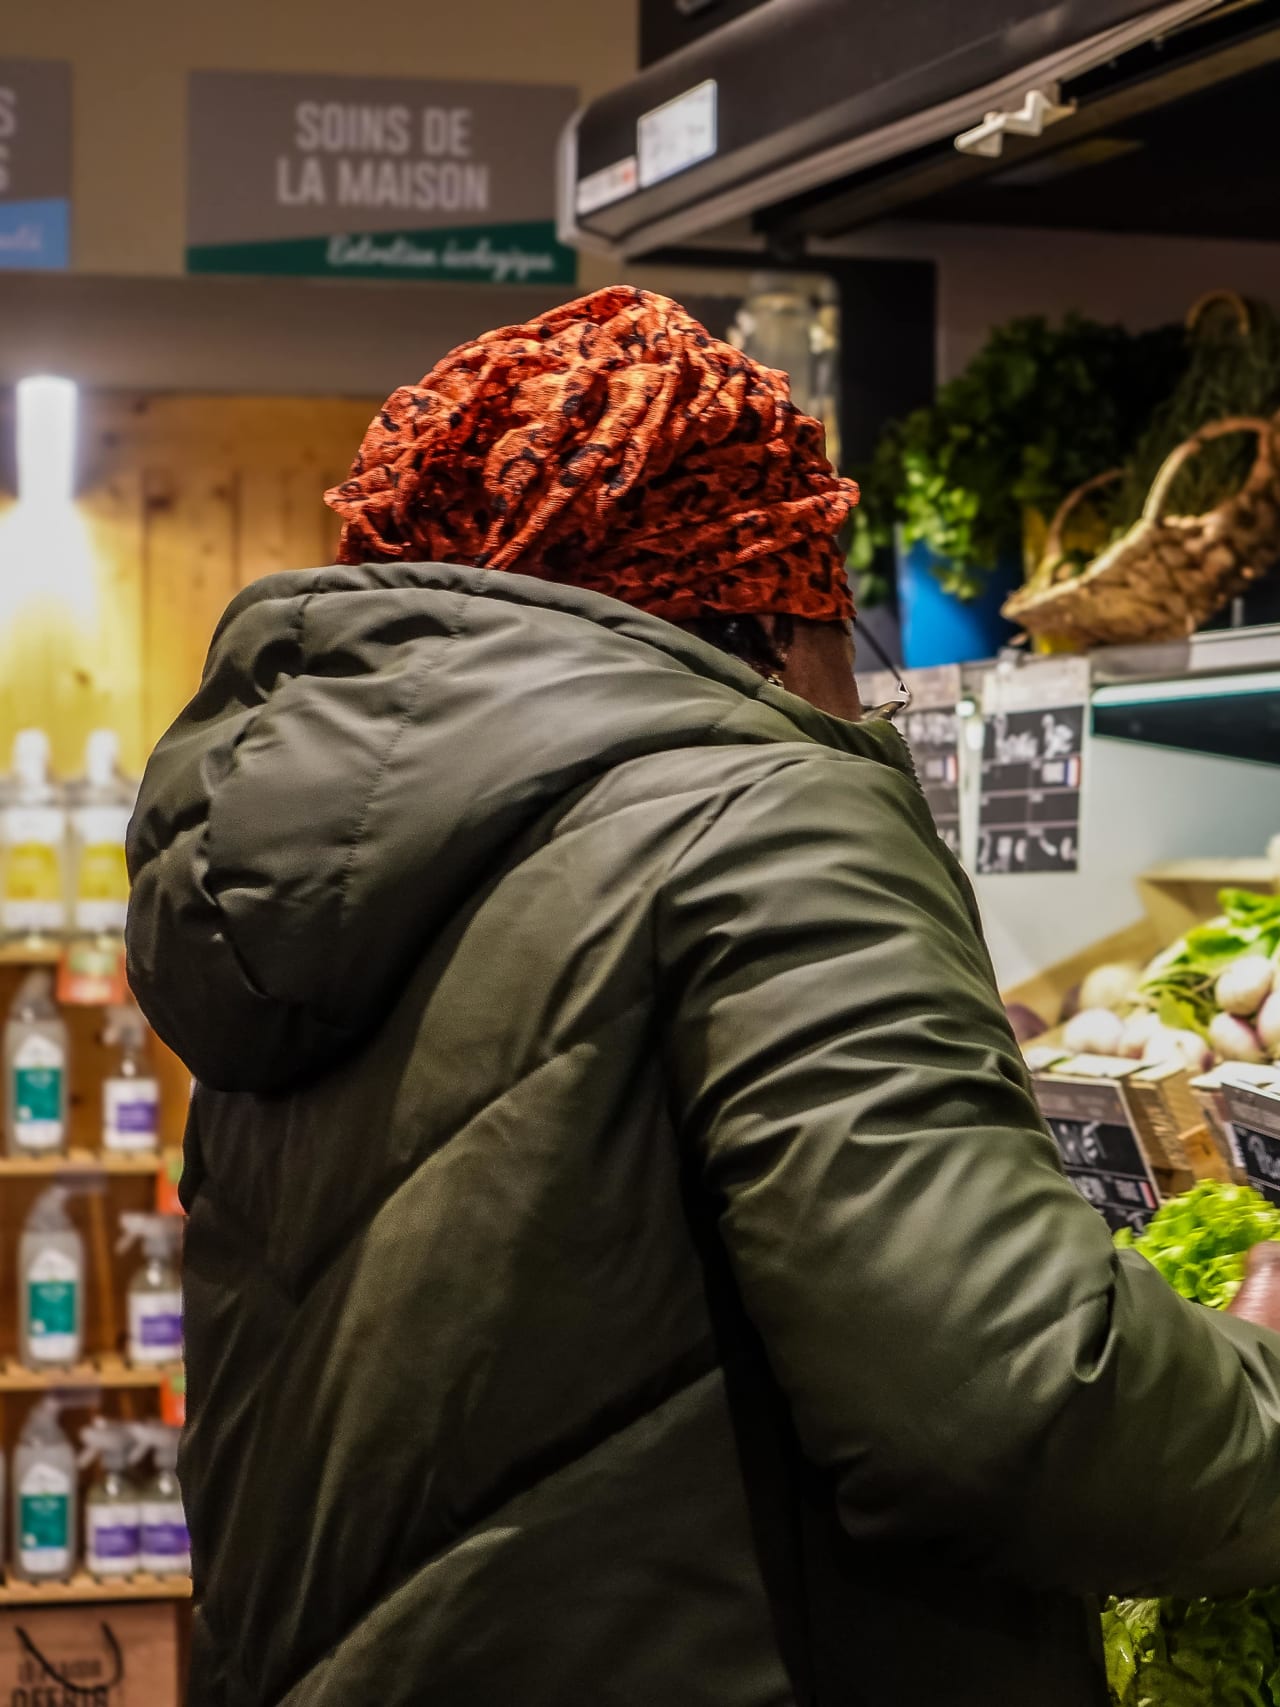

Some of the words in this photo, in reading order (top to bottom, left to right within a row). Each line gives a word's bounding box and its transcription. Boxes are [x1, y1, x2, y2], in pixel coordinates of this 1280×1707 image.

[296, 101, 411, 154] SOINS
[423, 107, 472, 157] DE
[276, 155, 325, 206] LA
[337, 158, 490, 213] MAISON
